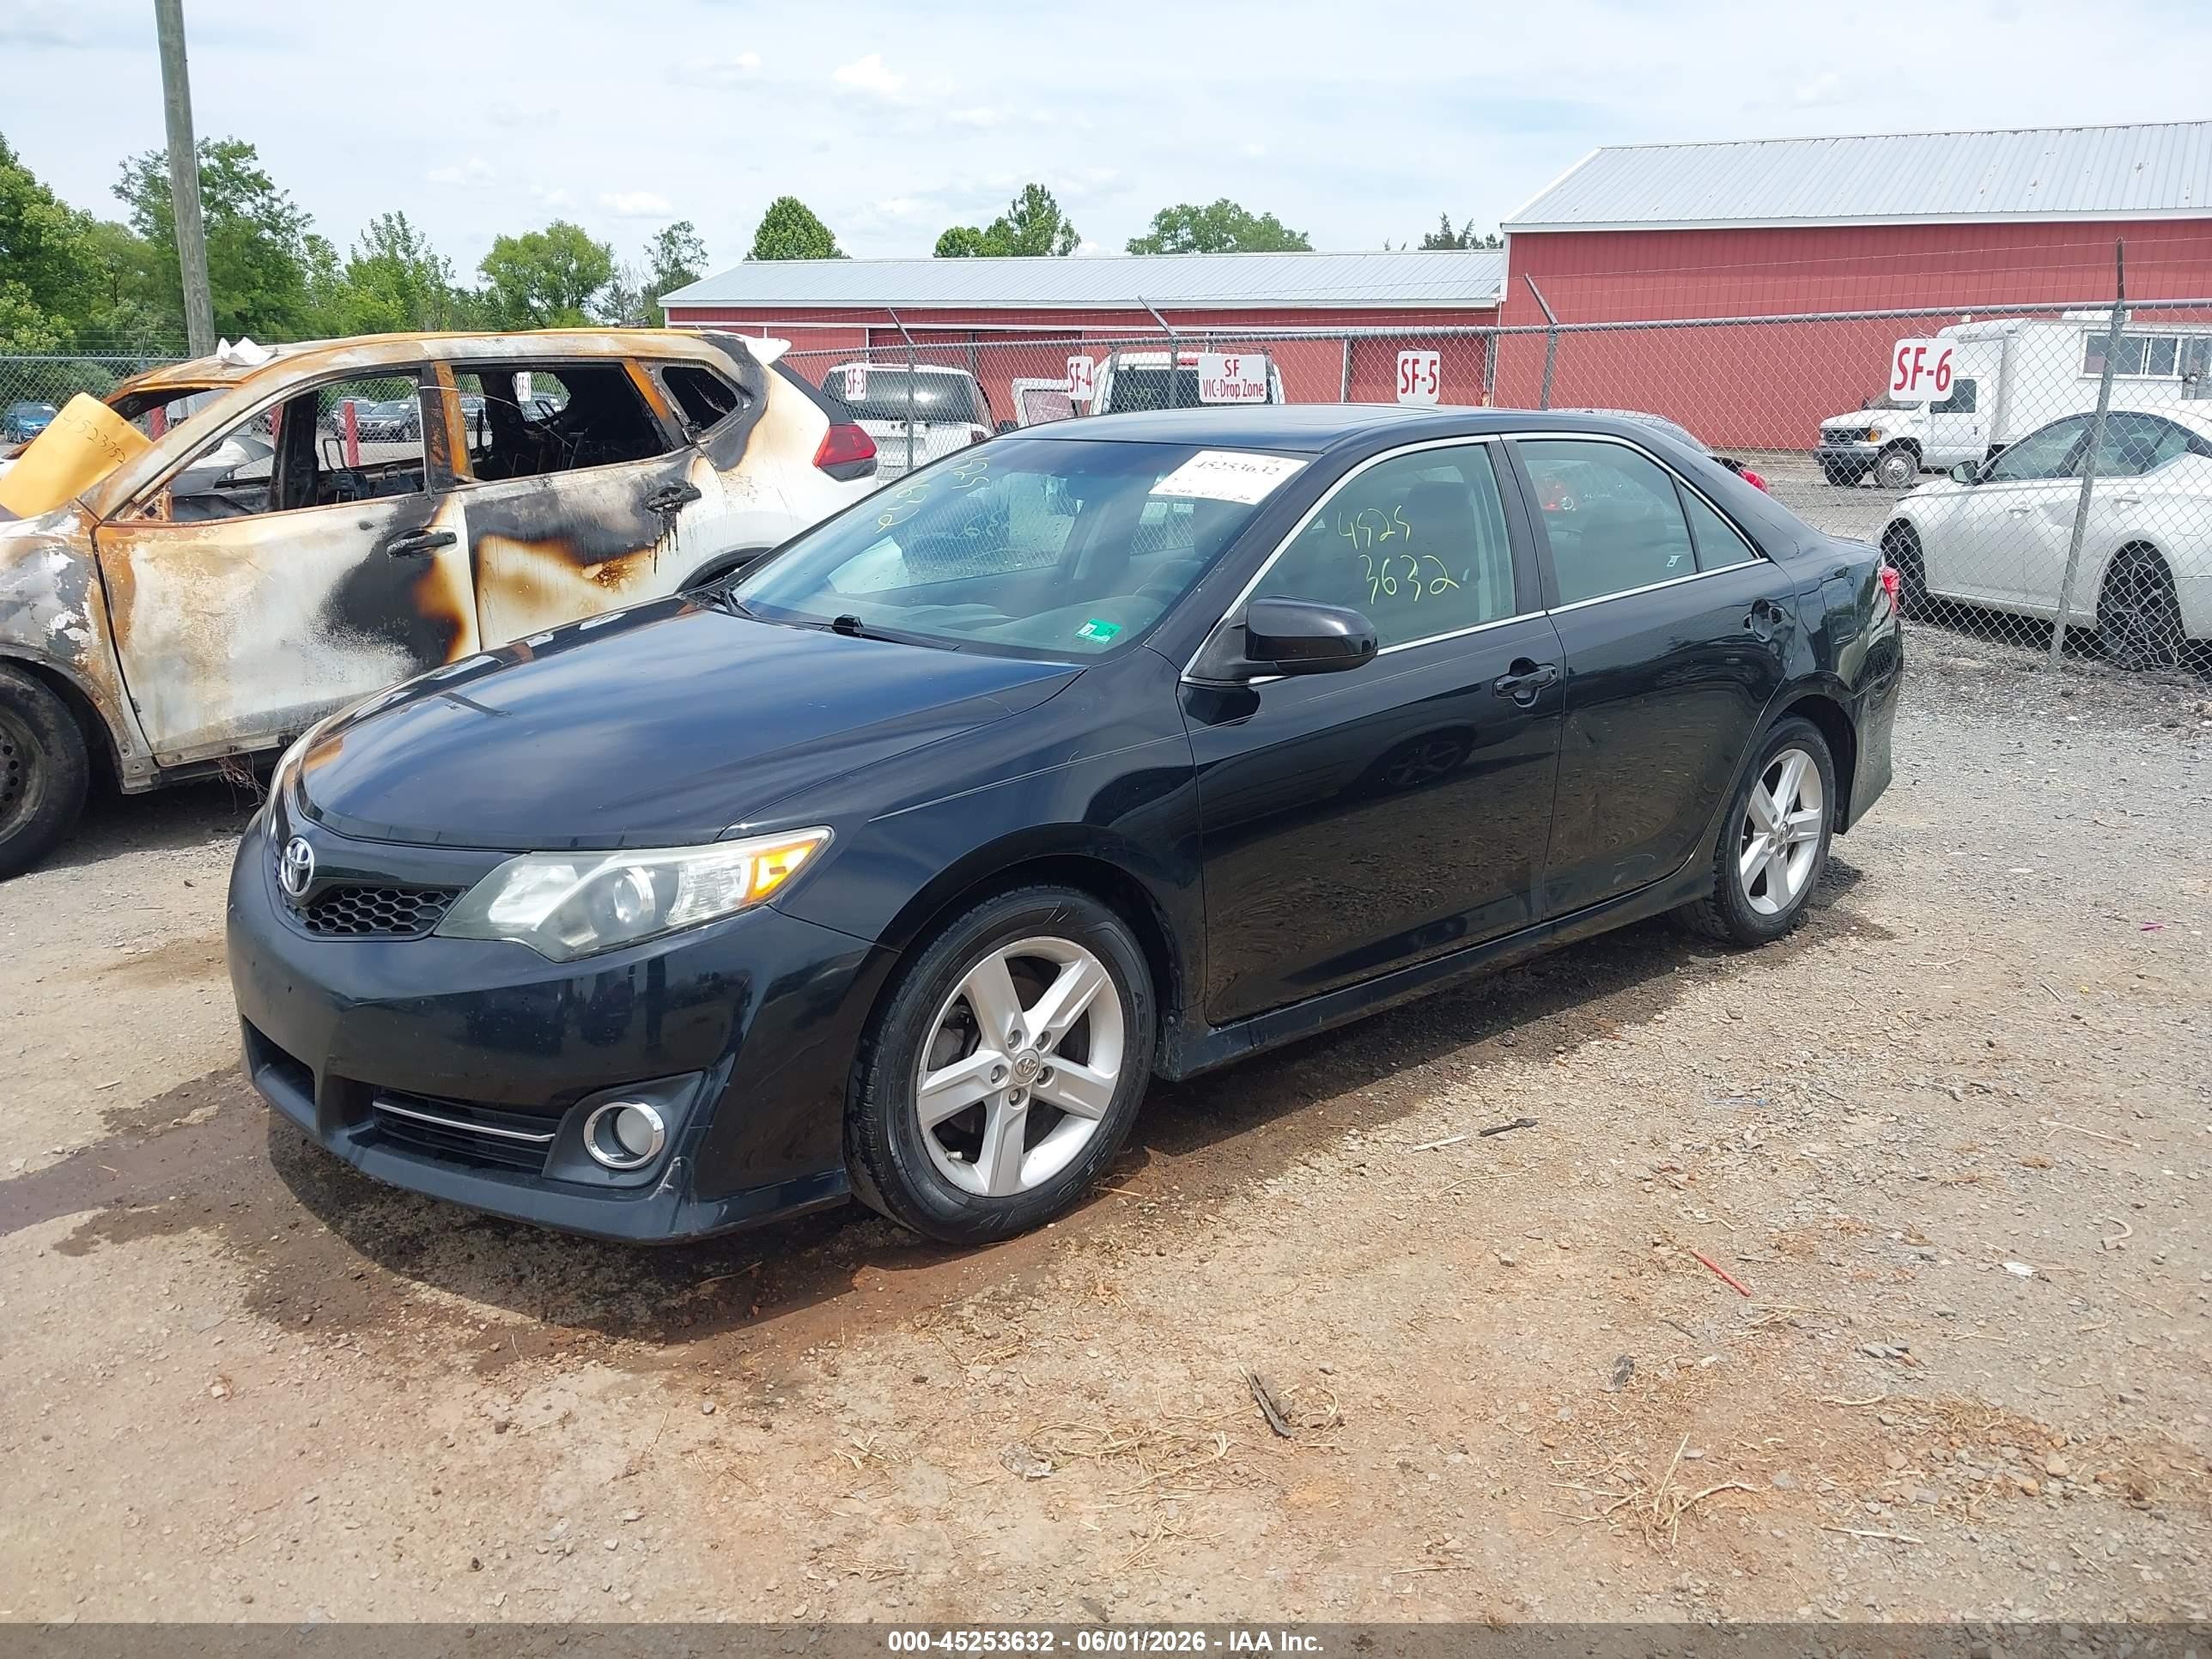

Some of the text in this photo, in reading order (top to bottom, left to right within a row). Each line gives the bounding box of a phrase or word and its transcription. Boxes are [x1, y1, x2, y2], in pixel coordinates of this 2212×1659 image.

[847, 368, 865, 395] SF-3
[1069, 362, 1092, 392] SF-4
[1224, 359, 1240, 377] SF
[1401, 358, 1437, 395] SF-5
[1893, 347, 1953, 392] SF-6
[1202, 379, 1264, 400] VIC-Drop Zone
[1338, 504, 1411, 550] 4525
[1358, 554, 1460, 605] 3632
